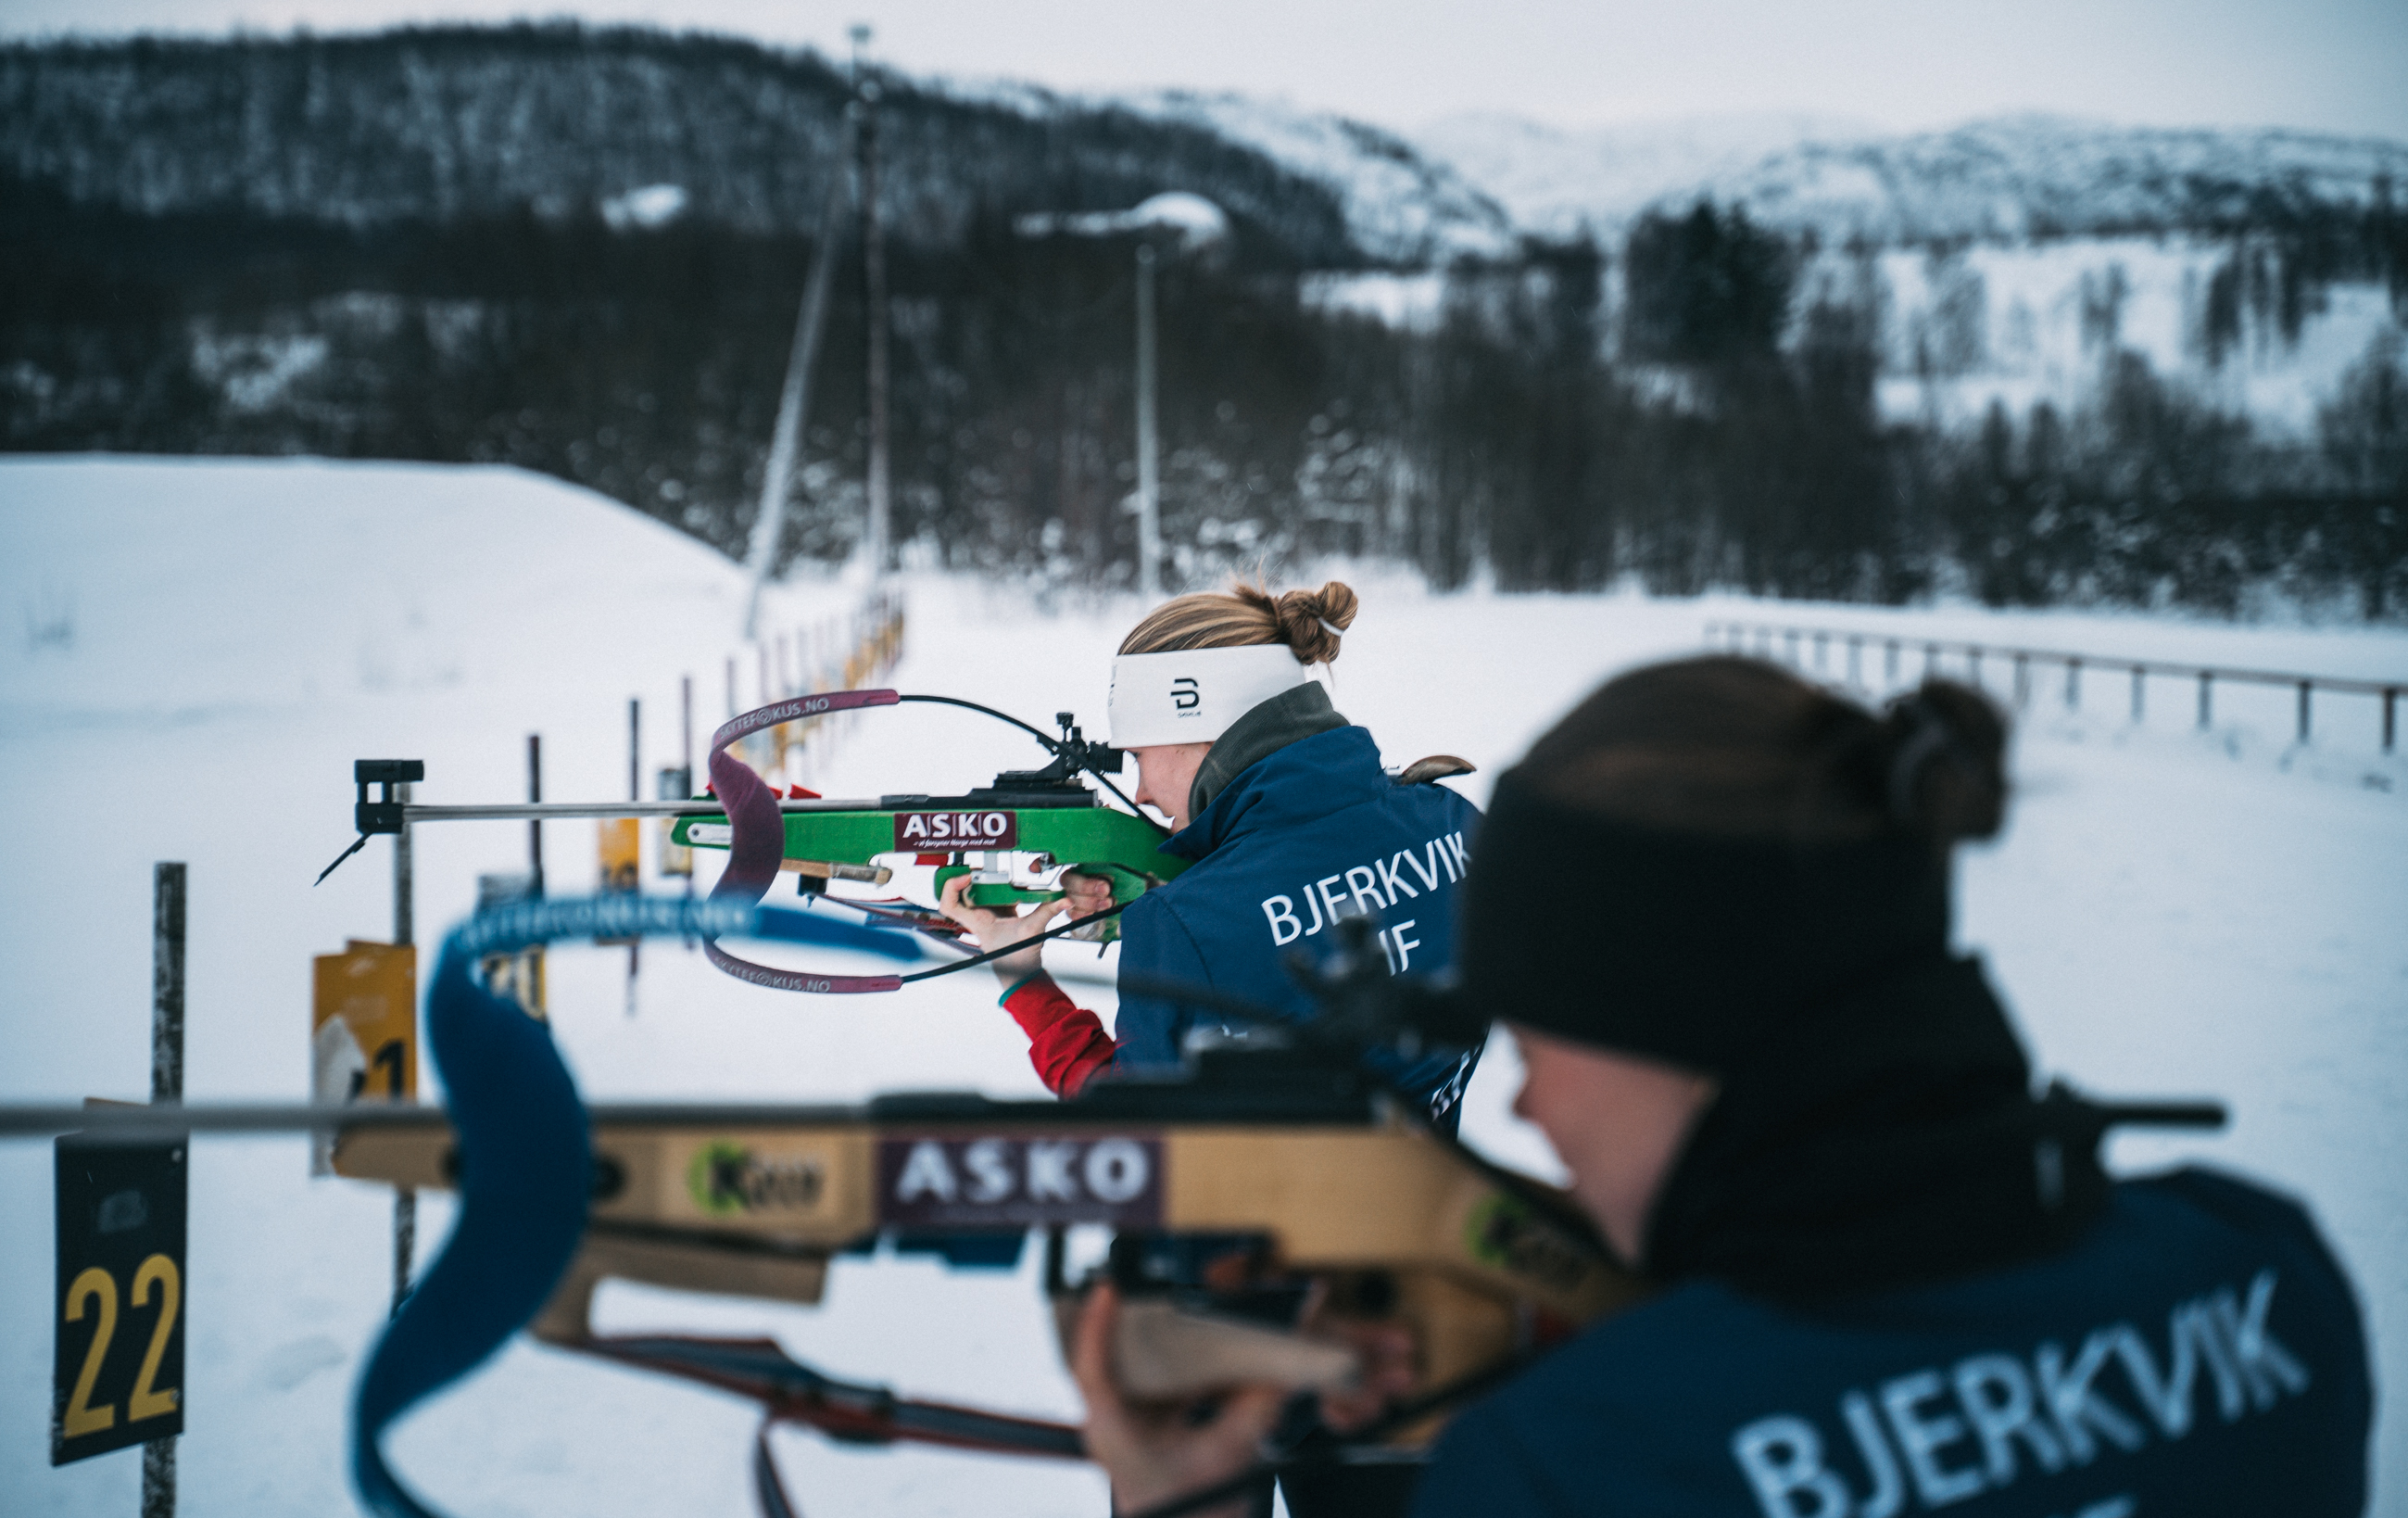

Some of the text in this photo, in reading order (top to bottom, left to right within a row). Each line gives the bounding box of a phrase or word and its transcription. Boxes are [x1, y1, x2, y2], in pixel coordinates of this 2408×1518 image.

[902, 812, 1008, 838] ASKO
[896, 1136, 1150, 1203] ASKO
[64, 1254, 182, 1439] 22
[1732, 1268, 2308, 1518] BJERKVIK
